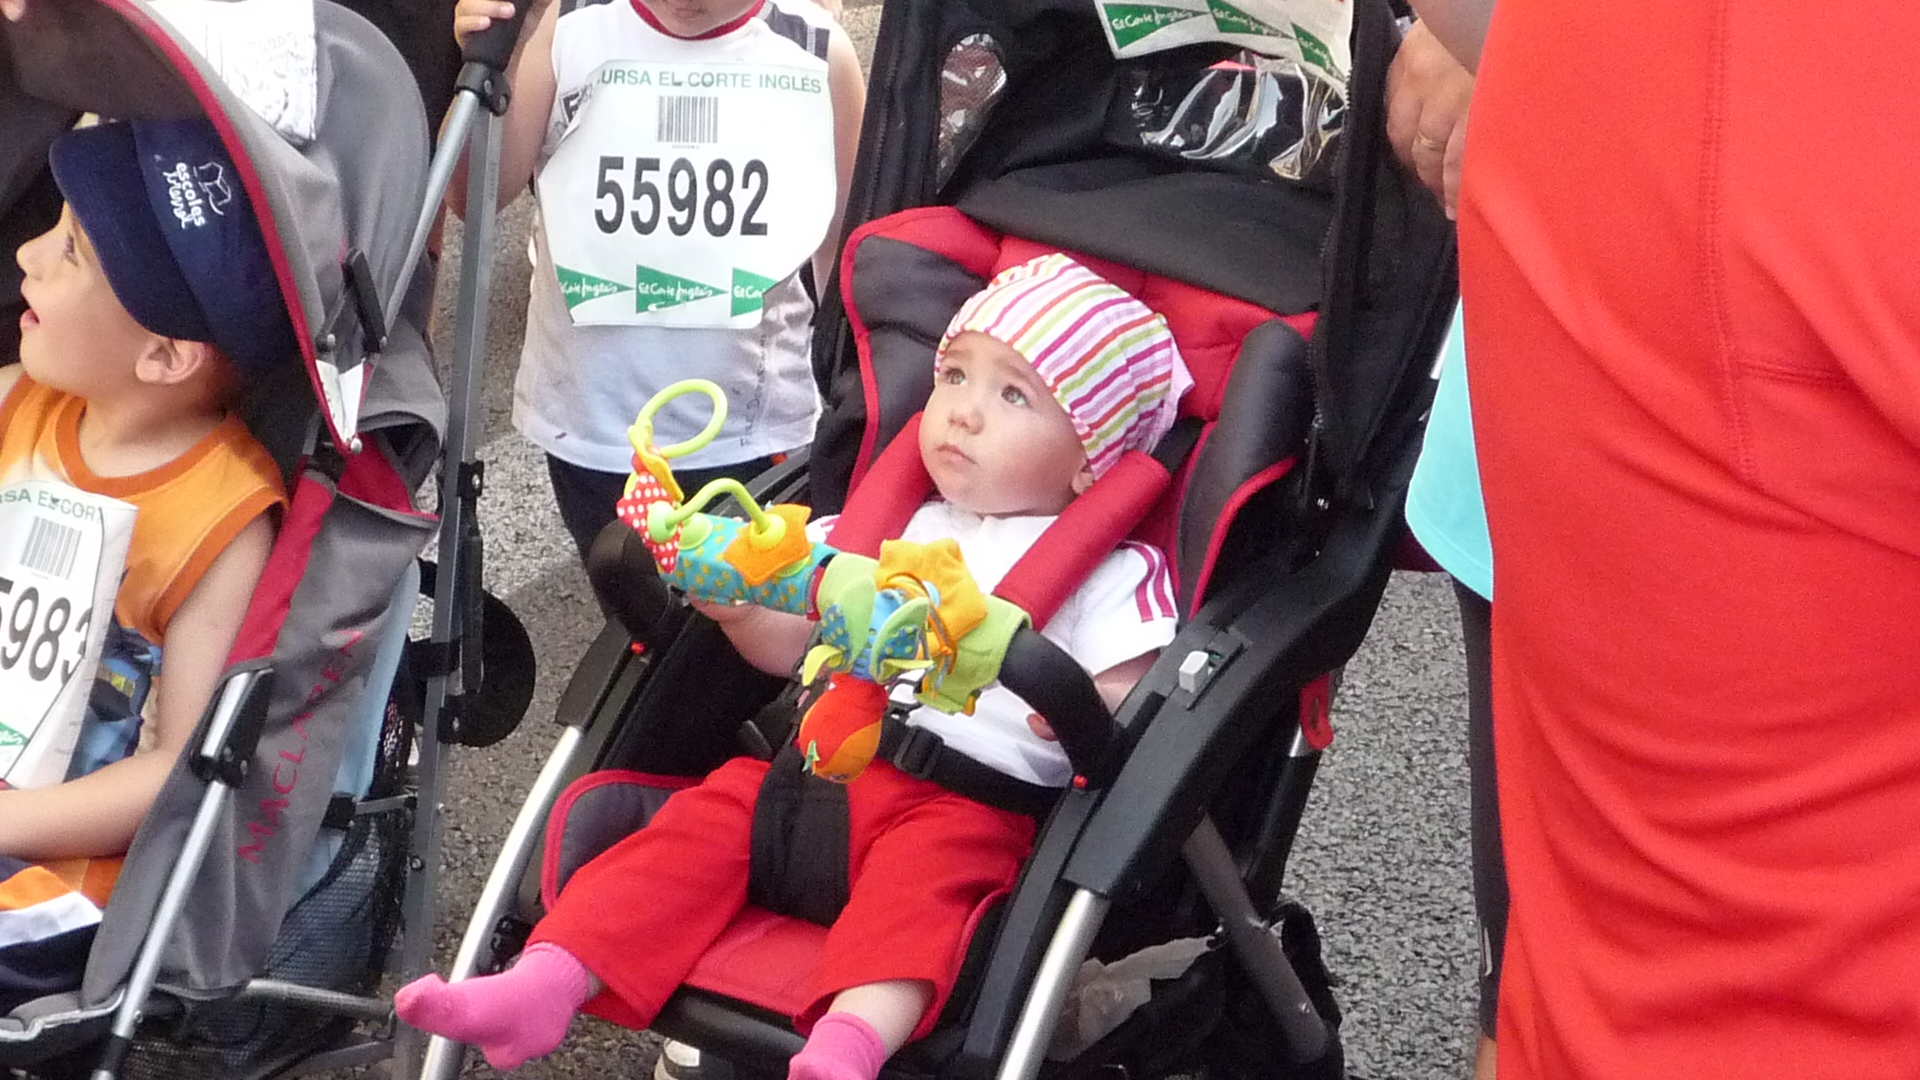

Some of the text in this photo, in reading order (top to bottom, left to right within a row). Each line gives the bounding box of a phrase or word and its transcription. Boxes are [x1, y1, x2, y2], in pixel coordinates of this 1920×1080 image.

[597, 68, 822, 94] URSA EL CORTE INGLÉS
[176, 162, 206, 227] escoles
[594, 155, 769, 237] 55982
[638, 281, 713, 301] El Corte Inglés
[733, 285, 745, 298] El
